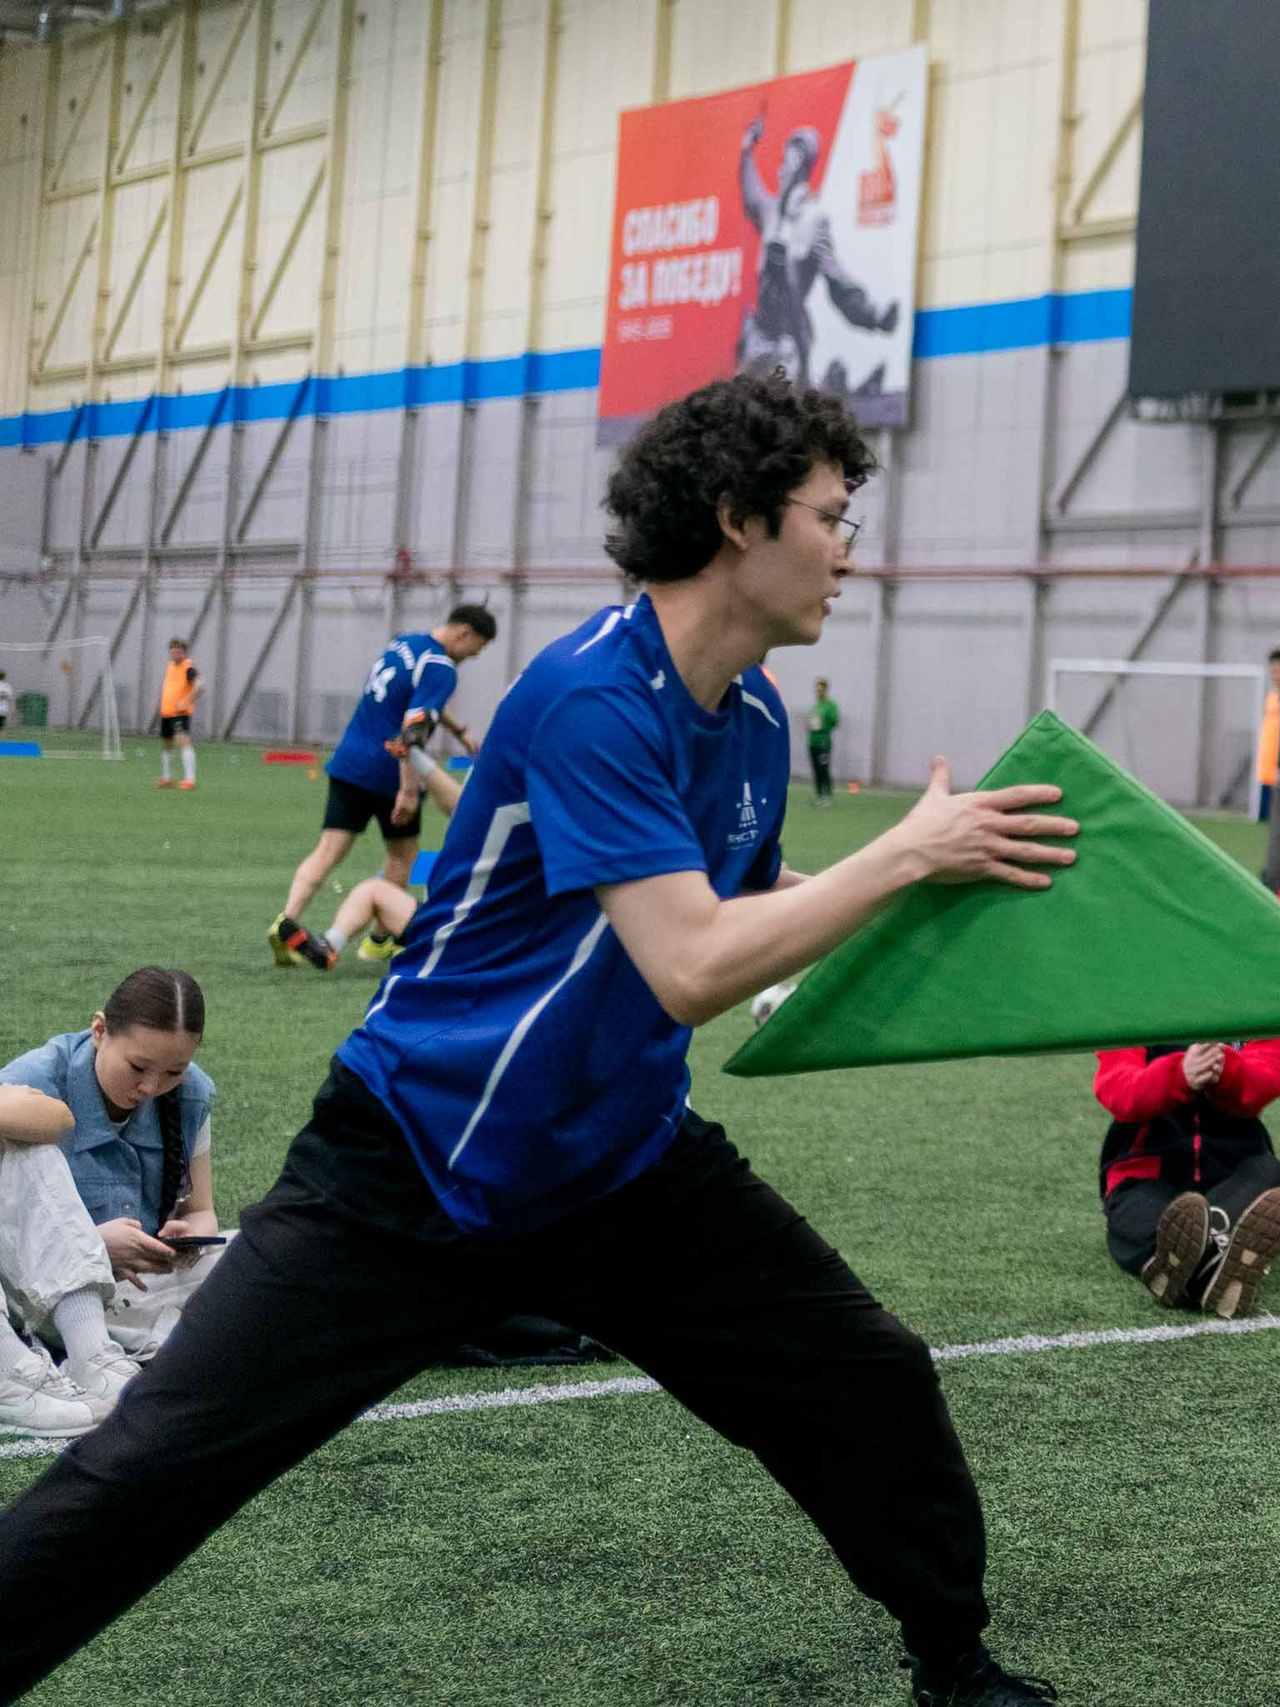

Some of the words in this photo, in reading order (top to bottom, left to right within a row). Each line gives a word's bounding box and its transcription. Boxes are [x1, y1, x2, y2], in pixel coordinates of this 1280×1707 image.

[623, 196, 719, 256] СПАСИБО
[619, 262, 647, 310] ЗА
[651, 248, 742, 308] ПОБЕДУ!
